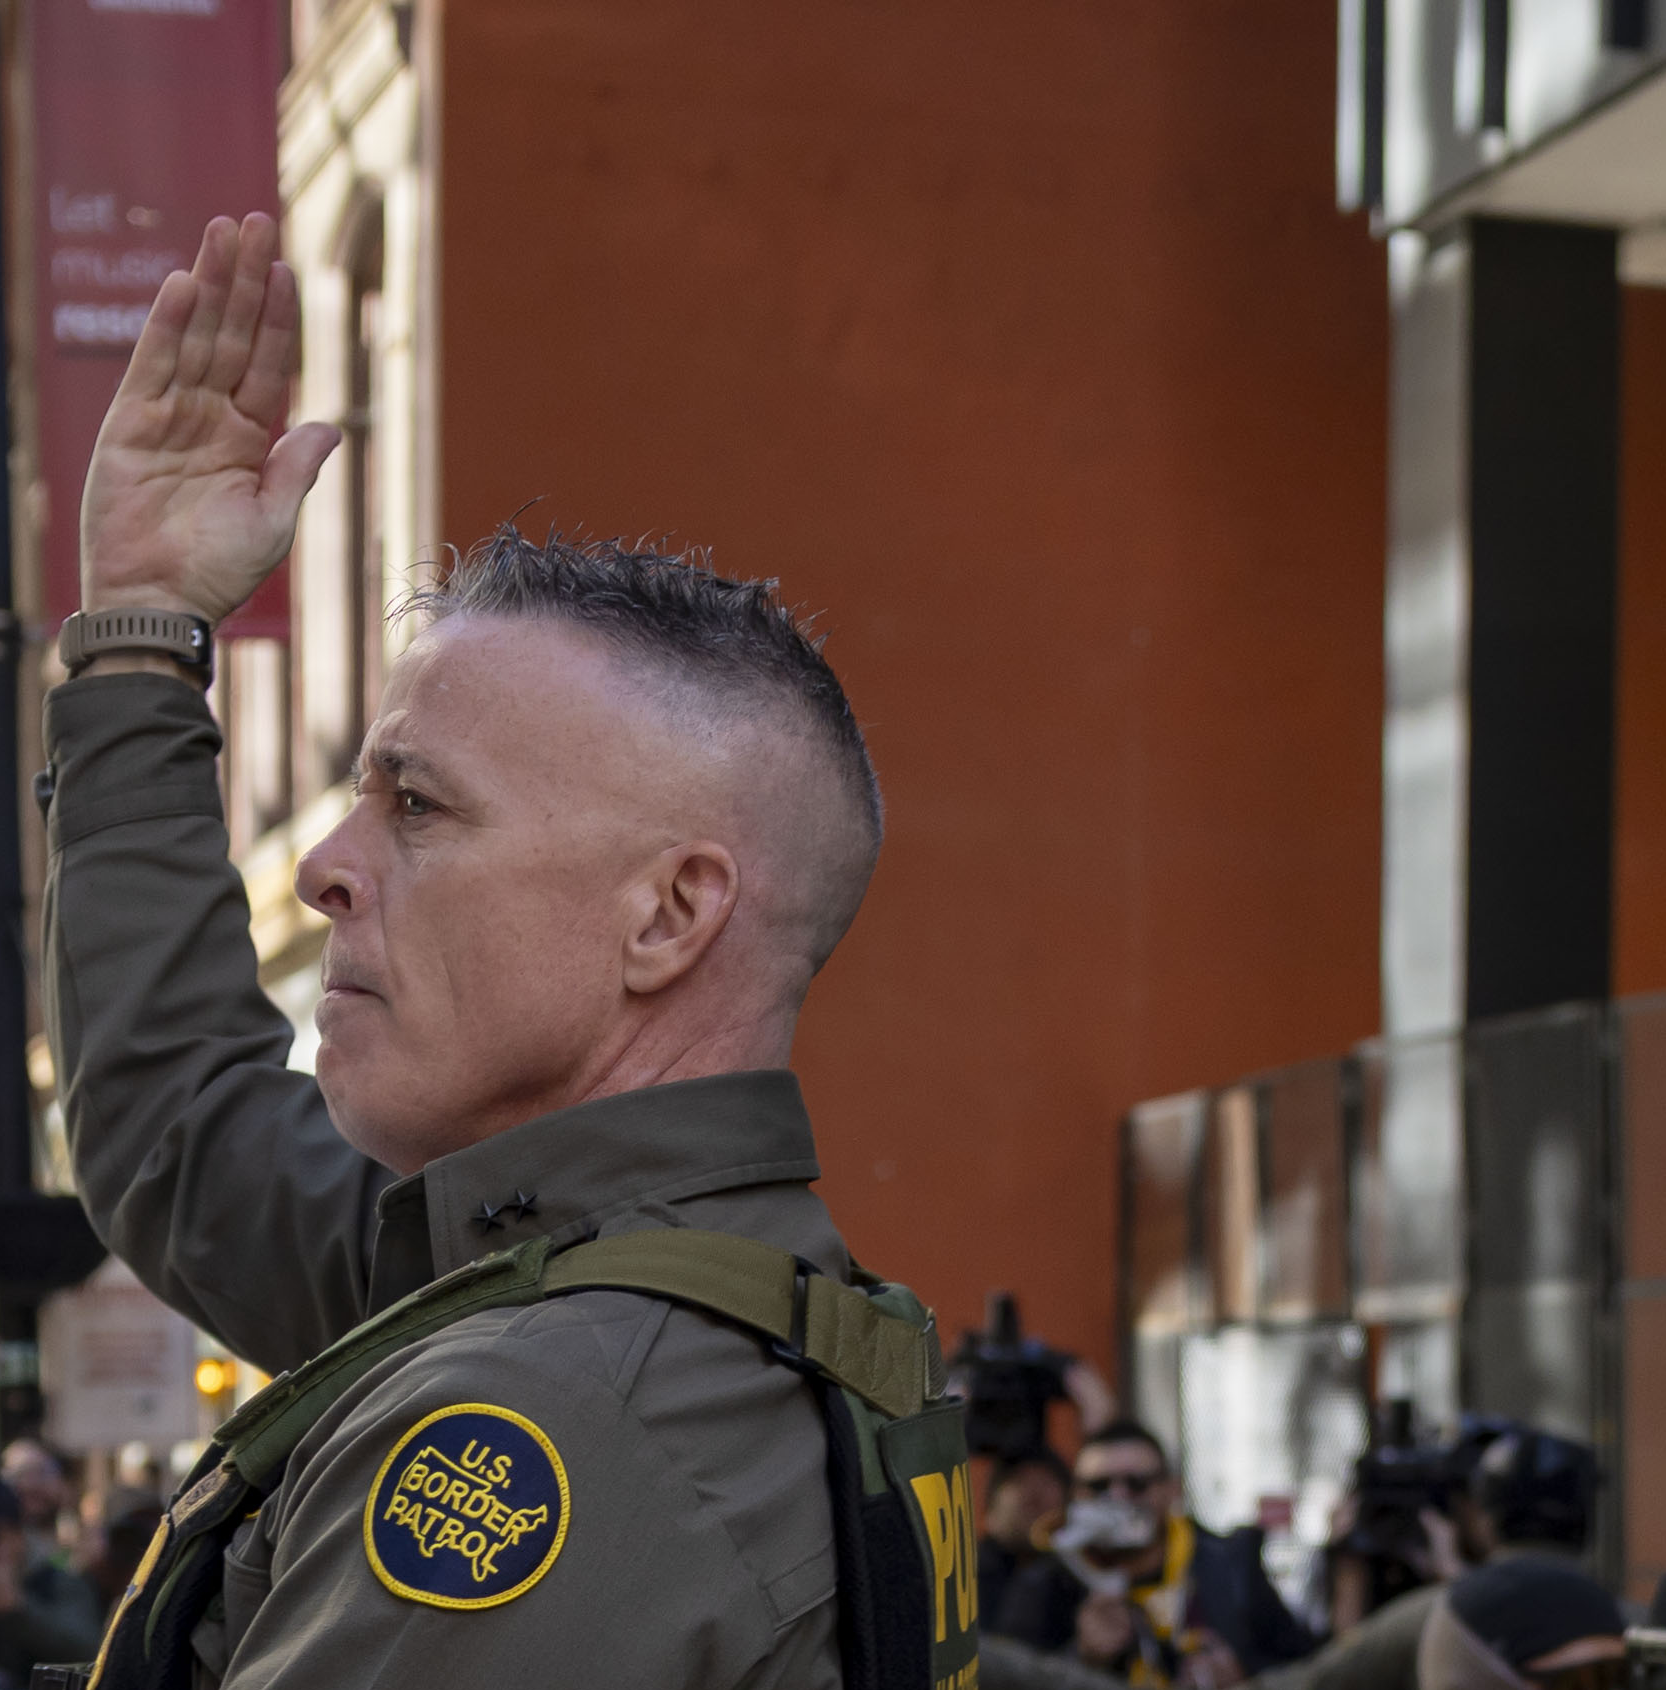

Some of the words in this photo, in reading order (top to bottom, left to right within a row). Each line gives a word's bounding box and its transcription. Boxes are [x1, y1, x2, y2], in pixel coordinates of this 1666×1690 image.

[401, 1463, 528, 1545] BORDER
[460, 1439, 512, 1489] U.S.
[384, 1495, 499, 1574] PATROL
[910, 1462, 979, 1643] POL
